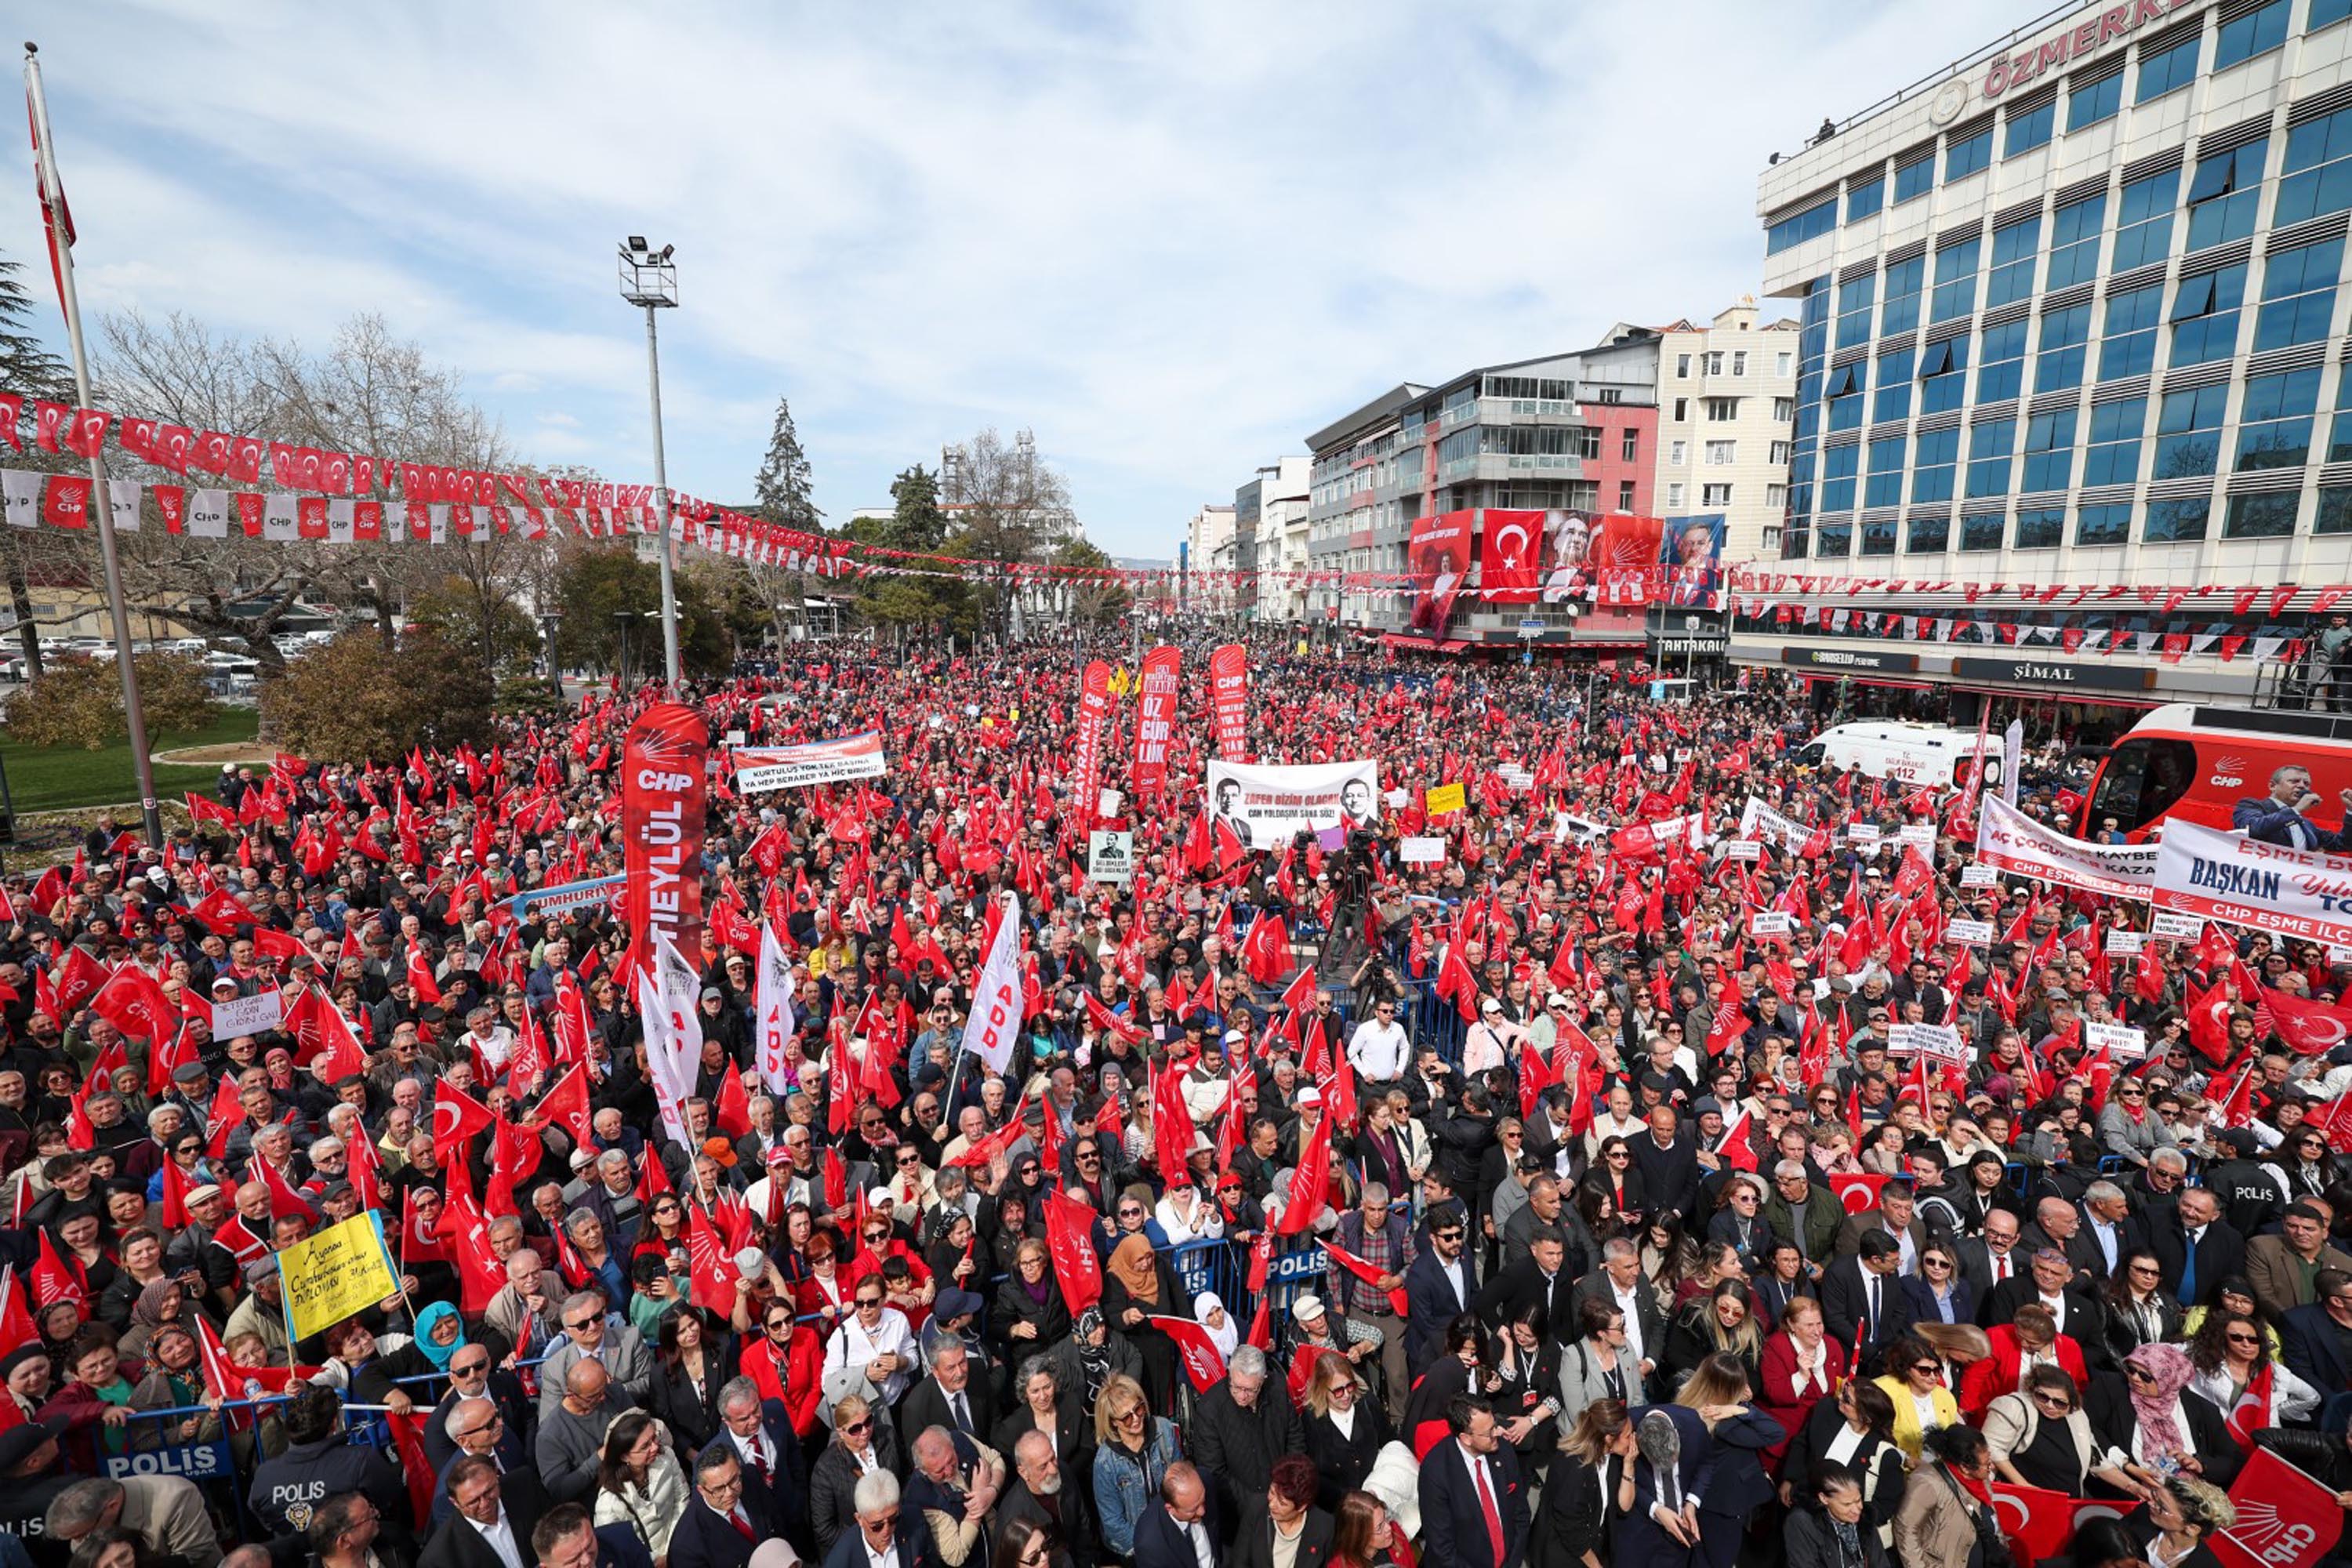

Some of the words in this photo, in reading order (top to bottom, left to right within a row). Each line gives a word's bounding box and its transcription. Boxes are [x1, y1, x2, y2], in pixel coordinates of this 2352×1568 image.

[57, 503, 82, 514] CHP
[269, 517, 292, 527] CHP
[332, 520, 349, 530] CHP
[359, 521, 375, 529] CHP
[2013, 662, 2075, 681] ŞİMAL
[1218, 676, 1243, 689] CHP
[1084, 693, 1105, 708] CHP
[1143, 694, 1163, 718] ÖZ
[1141, 717, 1169, 741] GÜR
[1074, 710, 1093, 808] BAYRAKLI
[1138, 739, 1165, 764] LÜK
[638, 769, 693, 793] CHP
[757, 778, 775, 786] HEP
[776, 772, 816, 784] BERABER
[1895, 766, 1916, 779] 112
[2210, 775, 2243, 788] CHP
[1243, 792, 1273, 805] ZAFER
[1274, 791, 1303, 805] BİZİM
[1304, 793, 1341, 806] OLACAK
[1264, 808, 1299, 821] YOLDAŞIM
[1299, 808, 1318, 818] SANA
[1319, 808, 1335, 818] SÖZ!
[1990, 829, 2012, 844] AÇ
[2105, 864, 2156, 876] KAZA
[2238, 838, 2314, 866] EŞME
[2013, 861, 2042, 874] CHP
[2189, 856, 2282, 901] BAŞKAN
[527, 882, 609, 909] CUMHURİY
[641, 800, 683, 984] TIEYLÜL
[2212, 903, 2252, 920] CHP
[2256, 912, 2312, 934] EŞME
[2318, 923, 2352, 942] İLÇ
[729, 927, 750, 942] CHP
[982, 983, 1013, 1050] ADD
[2235, 1186, 2274, 1202] POLİS
[1265, 1249, 1329, 1280] POLİS
[106, 1445, 217, 1480] POLİS
[184, 1467, 218, 1476] UŞAK
